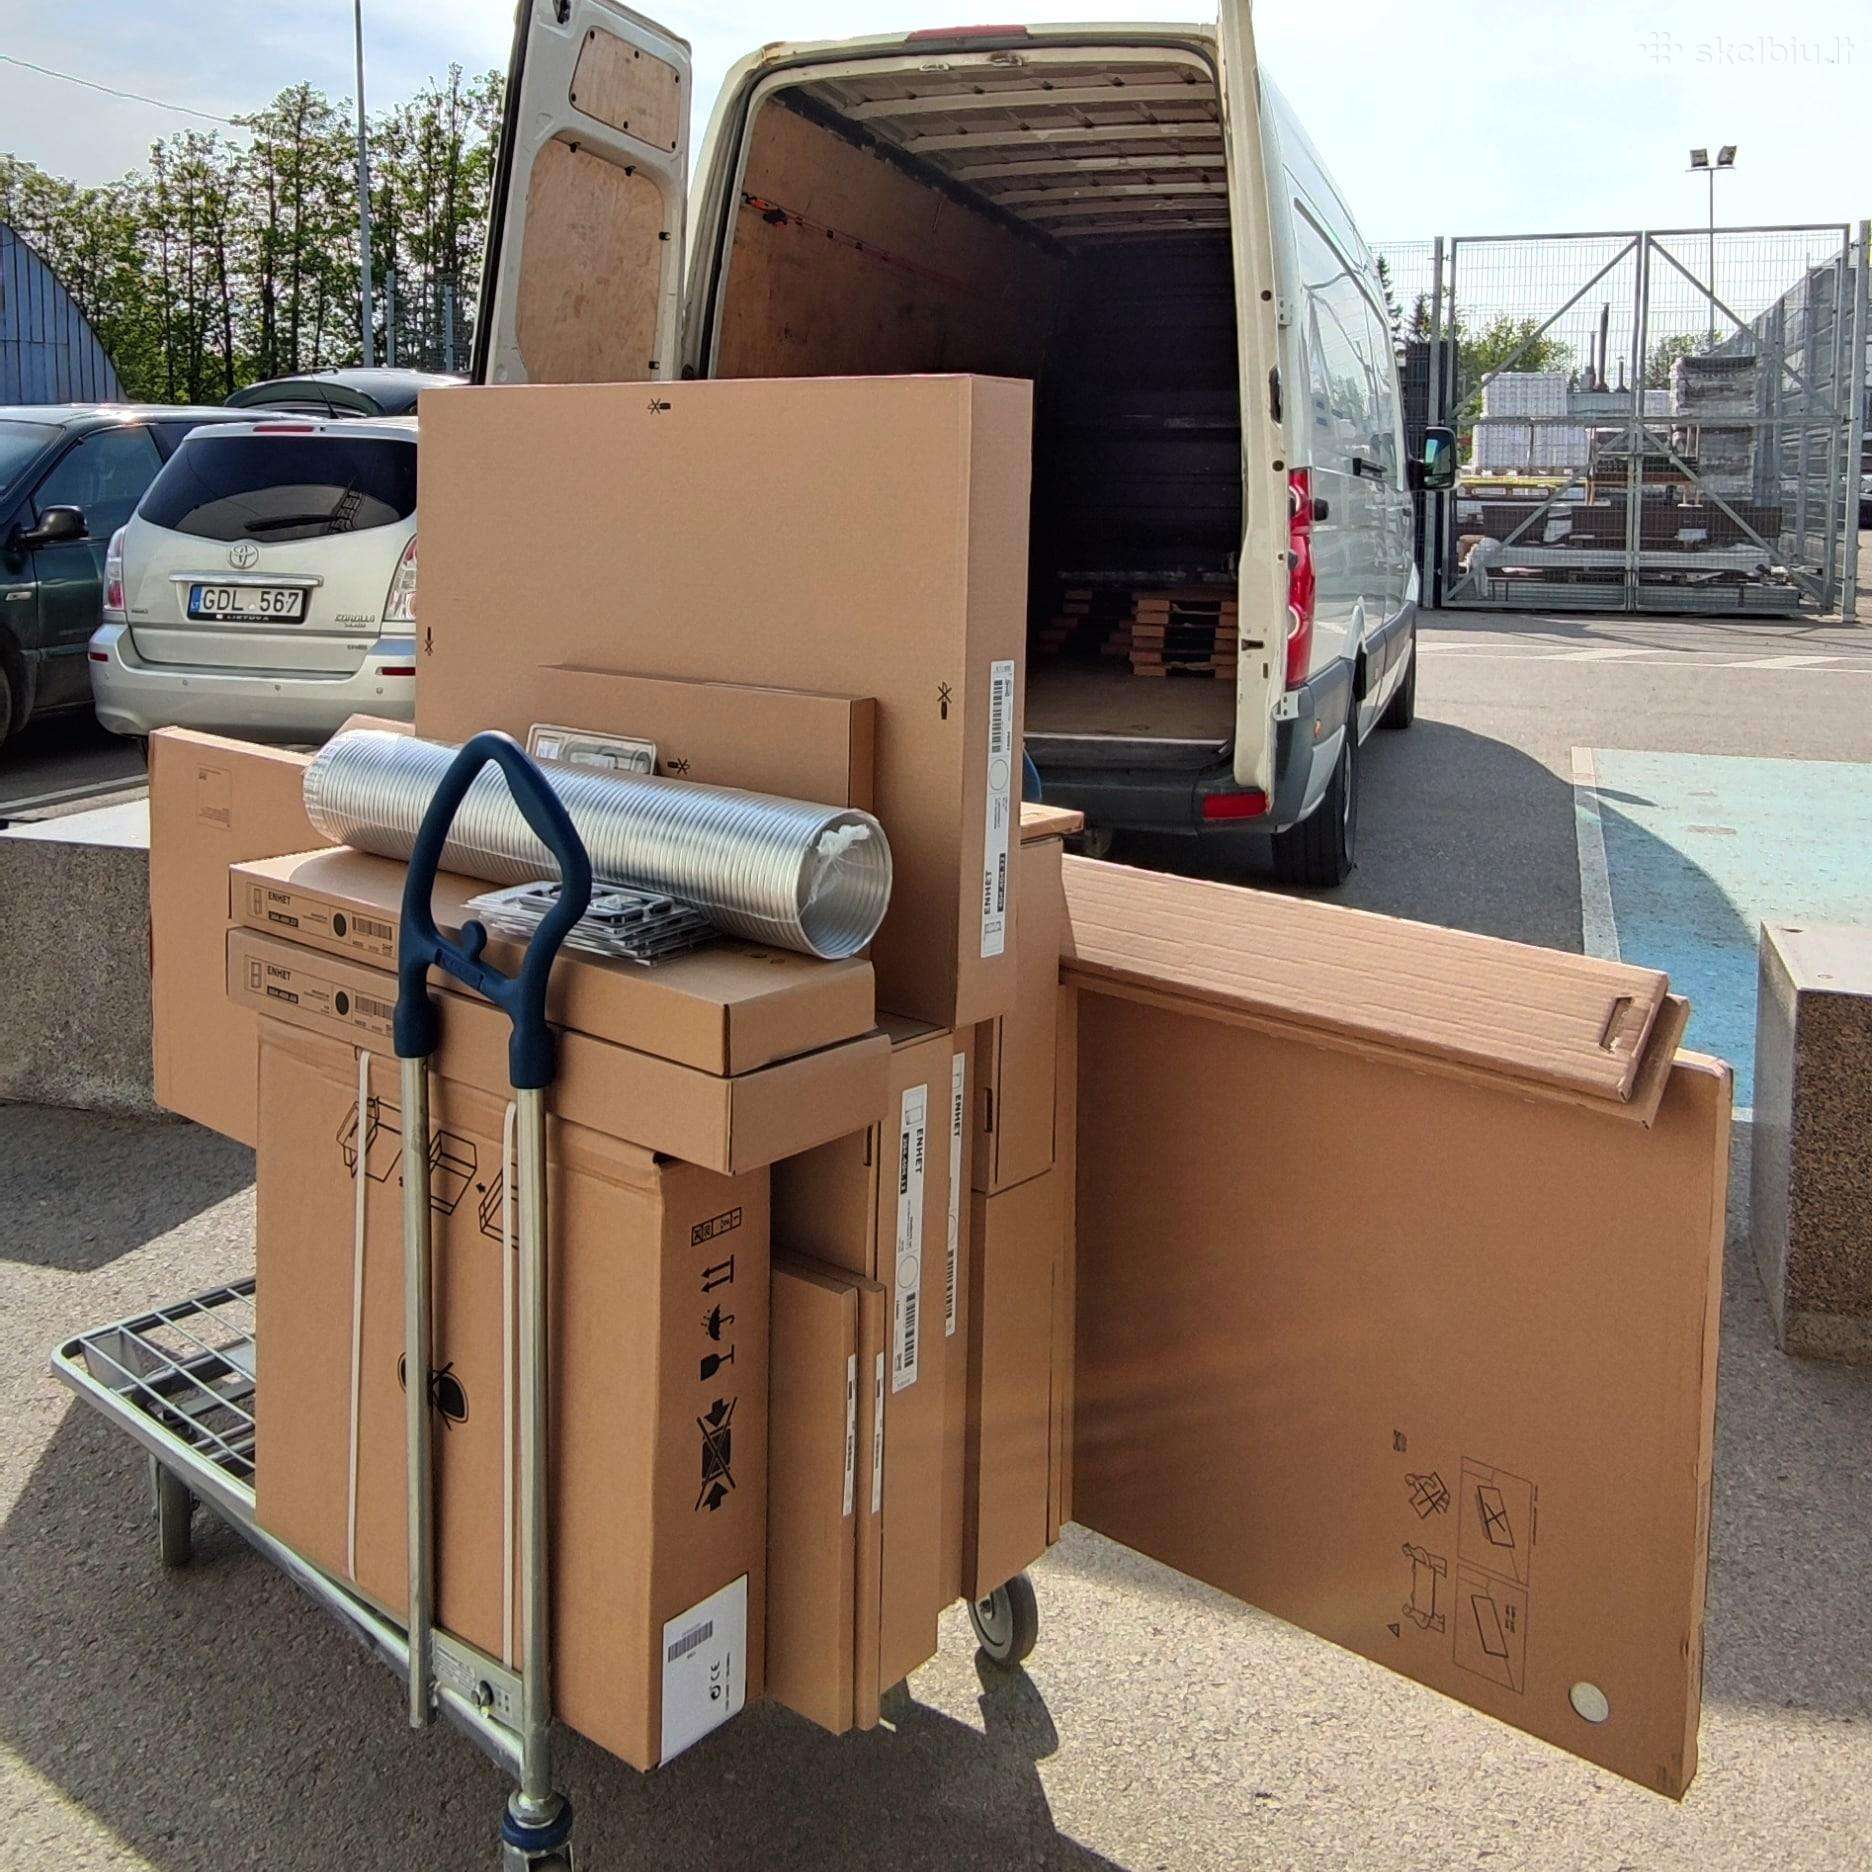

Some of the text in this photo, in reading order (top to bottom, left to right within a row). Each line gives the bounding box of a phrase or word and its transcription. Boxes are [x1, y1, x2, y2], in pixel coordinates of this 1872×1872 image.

[203, 589, 244, 611] GDL
[259, 590, 300, 614] 567
[268, 891, 291, 905] ENHET
[984, 870, 992, 915] ENHET
[267, 965, 291, 981] ENHET
[954, 1094, 962, 1137] ENHET
[915, 1128, 924, 1173] ENHET
